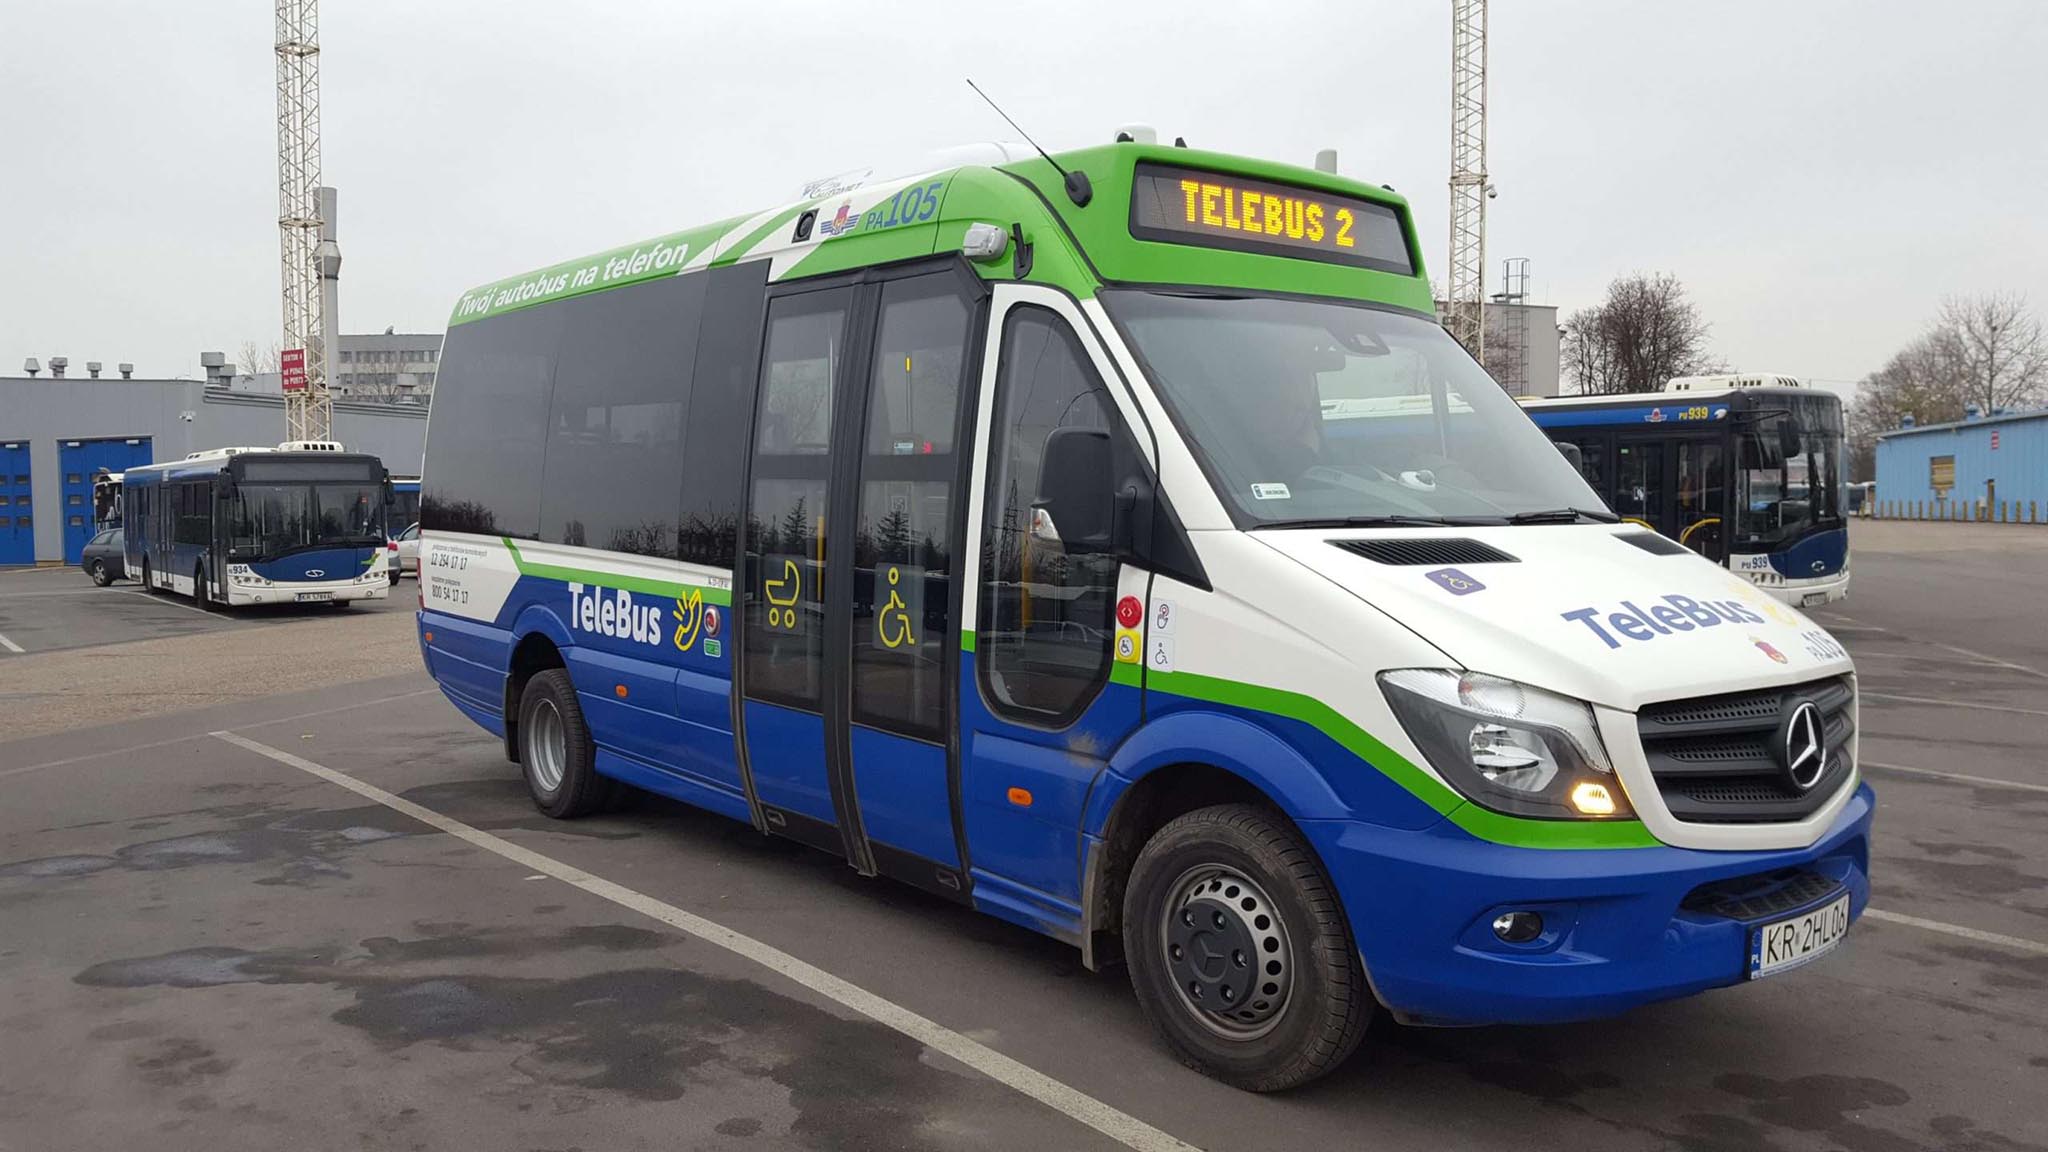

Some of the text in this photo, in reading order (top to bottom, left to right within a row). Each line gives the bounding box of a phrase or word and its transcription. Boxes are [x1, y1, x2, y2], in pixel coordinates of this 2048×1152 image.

[1181, 180, 1355, 248] TELEBUS 2
[458, 242, 689, 318] Twój autobus na telefon
[567, 581, 662, 647] TeleBus
[1560, 594, 1765, 650] TeleBus
[1766, 924, 1796, 965] KR
[1801, 900, 1846, 953] 2HL06
